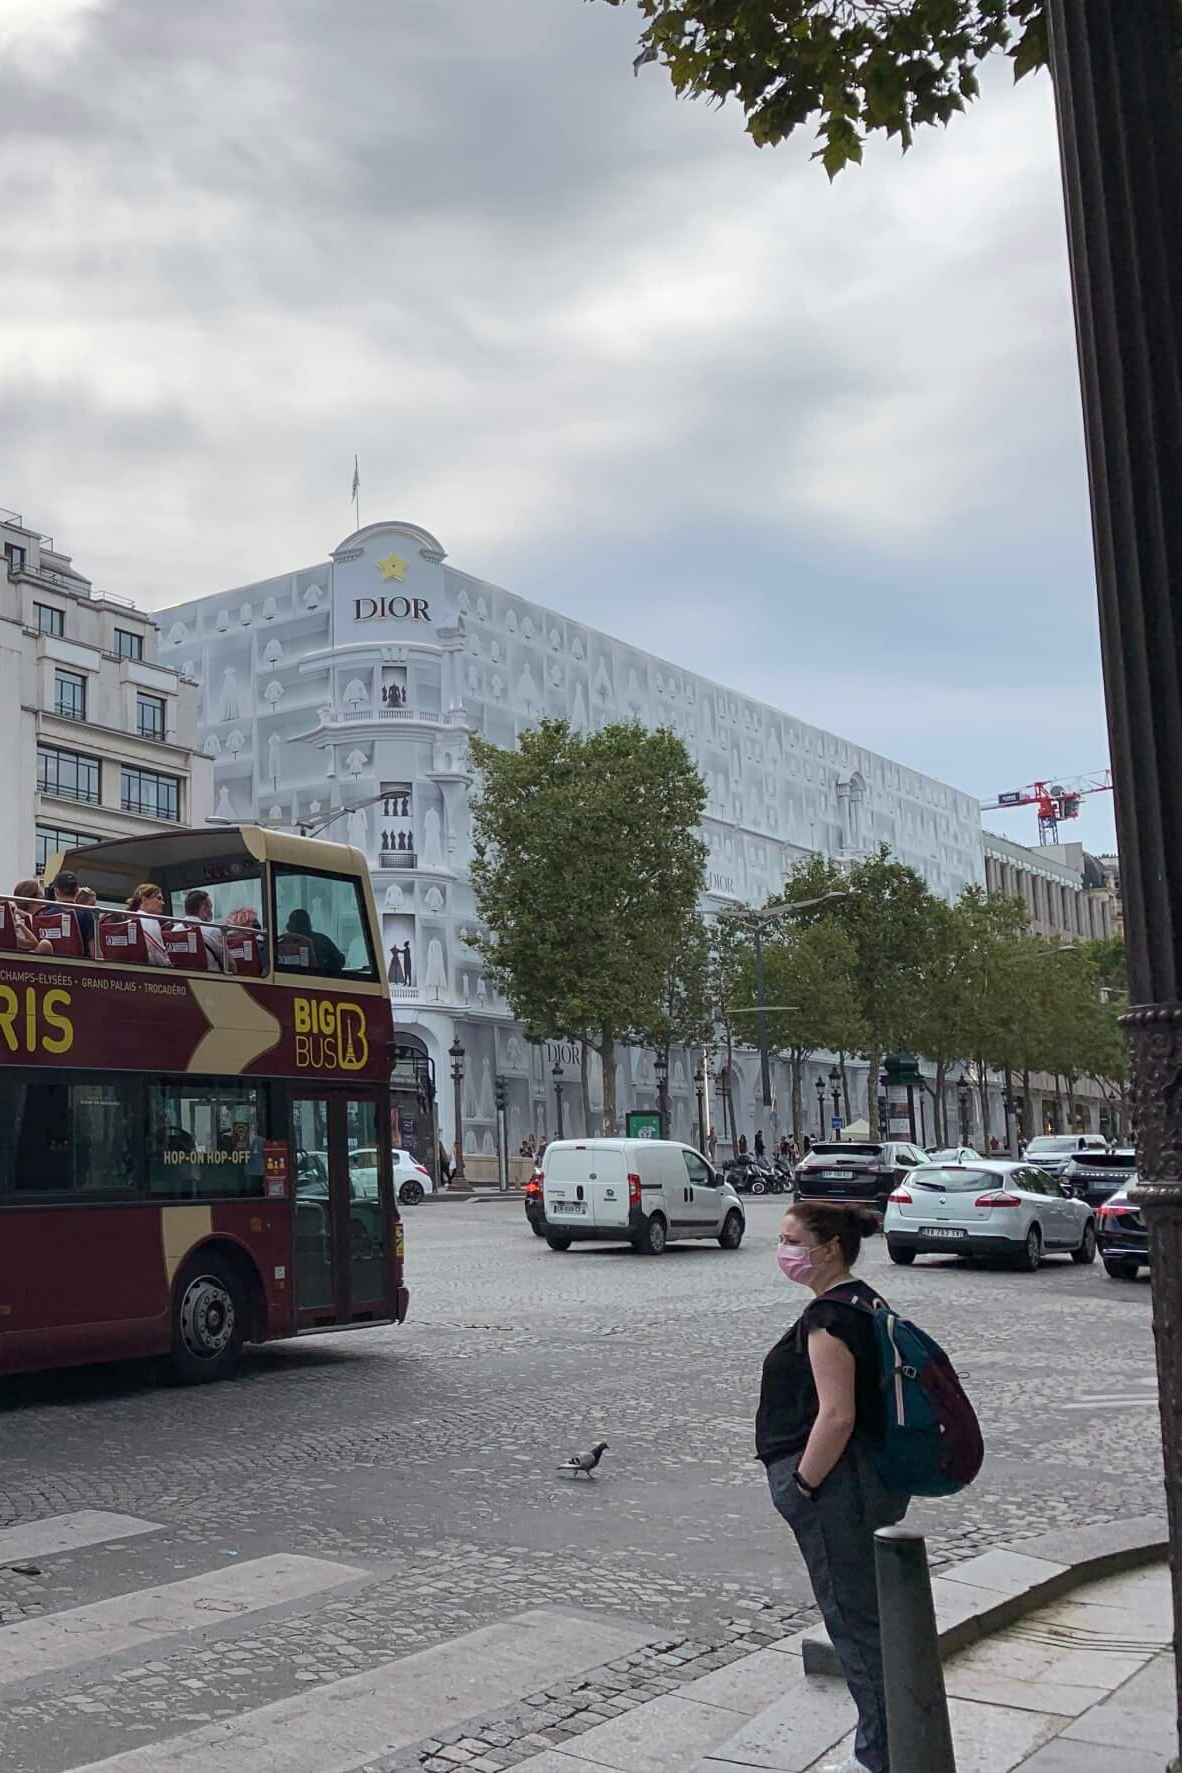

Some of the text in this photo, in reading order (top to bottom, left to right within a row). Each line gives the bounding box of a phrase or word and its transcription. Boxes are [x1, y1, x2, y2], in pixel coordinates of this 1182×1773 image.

[352, 596, 433, 622] DIOR
[81, 978, 109, 990] GRAND
[110, 980, 137, 992] PALAIS
[143, 982, 187, 996] TROCADÉRO
[293, 997, 336, 1035] BIG
[295, 1036, 337, 1070] BUS
[547, 1042, 582, 1065] DIOR
[163, 1150, 251, 1165] HOP-ON HOP-OFF
